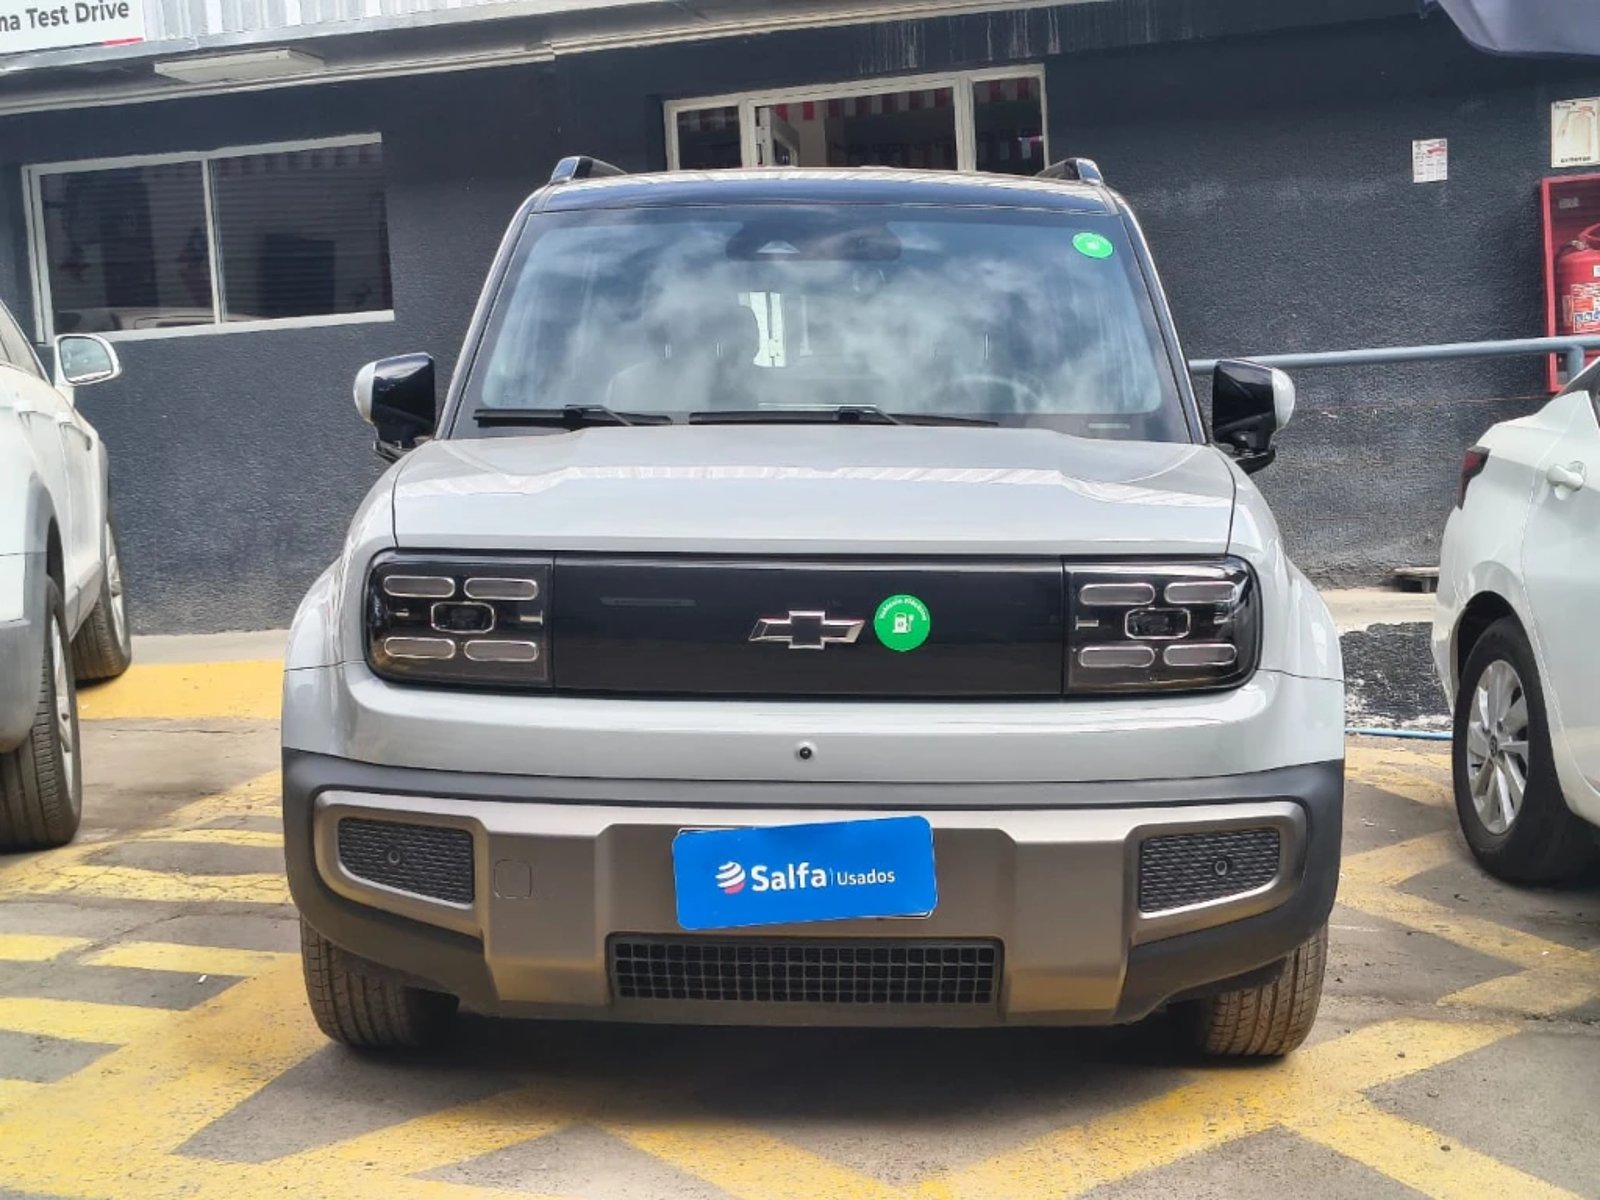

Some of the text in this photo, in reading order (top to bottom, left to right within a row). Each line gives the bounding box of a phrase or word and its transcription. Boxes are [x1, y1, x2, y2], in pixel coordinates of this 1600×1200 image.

[25, 6, 69, 28] Test
[75, 0, 129, 23] Drive
[751, 862, 896, 892] Salfa Usados
